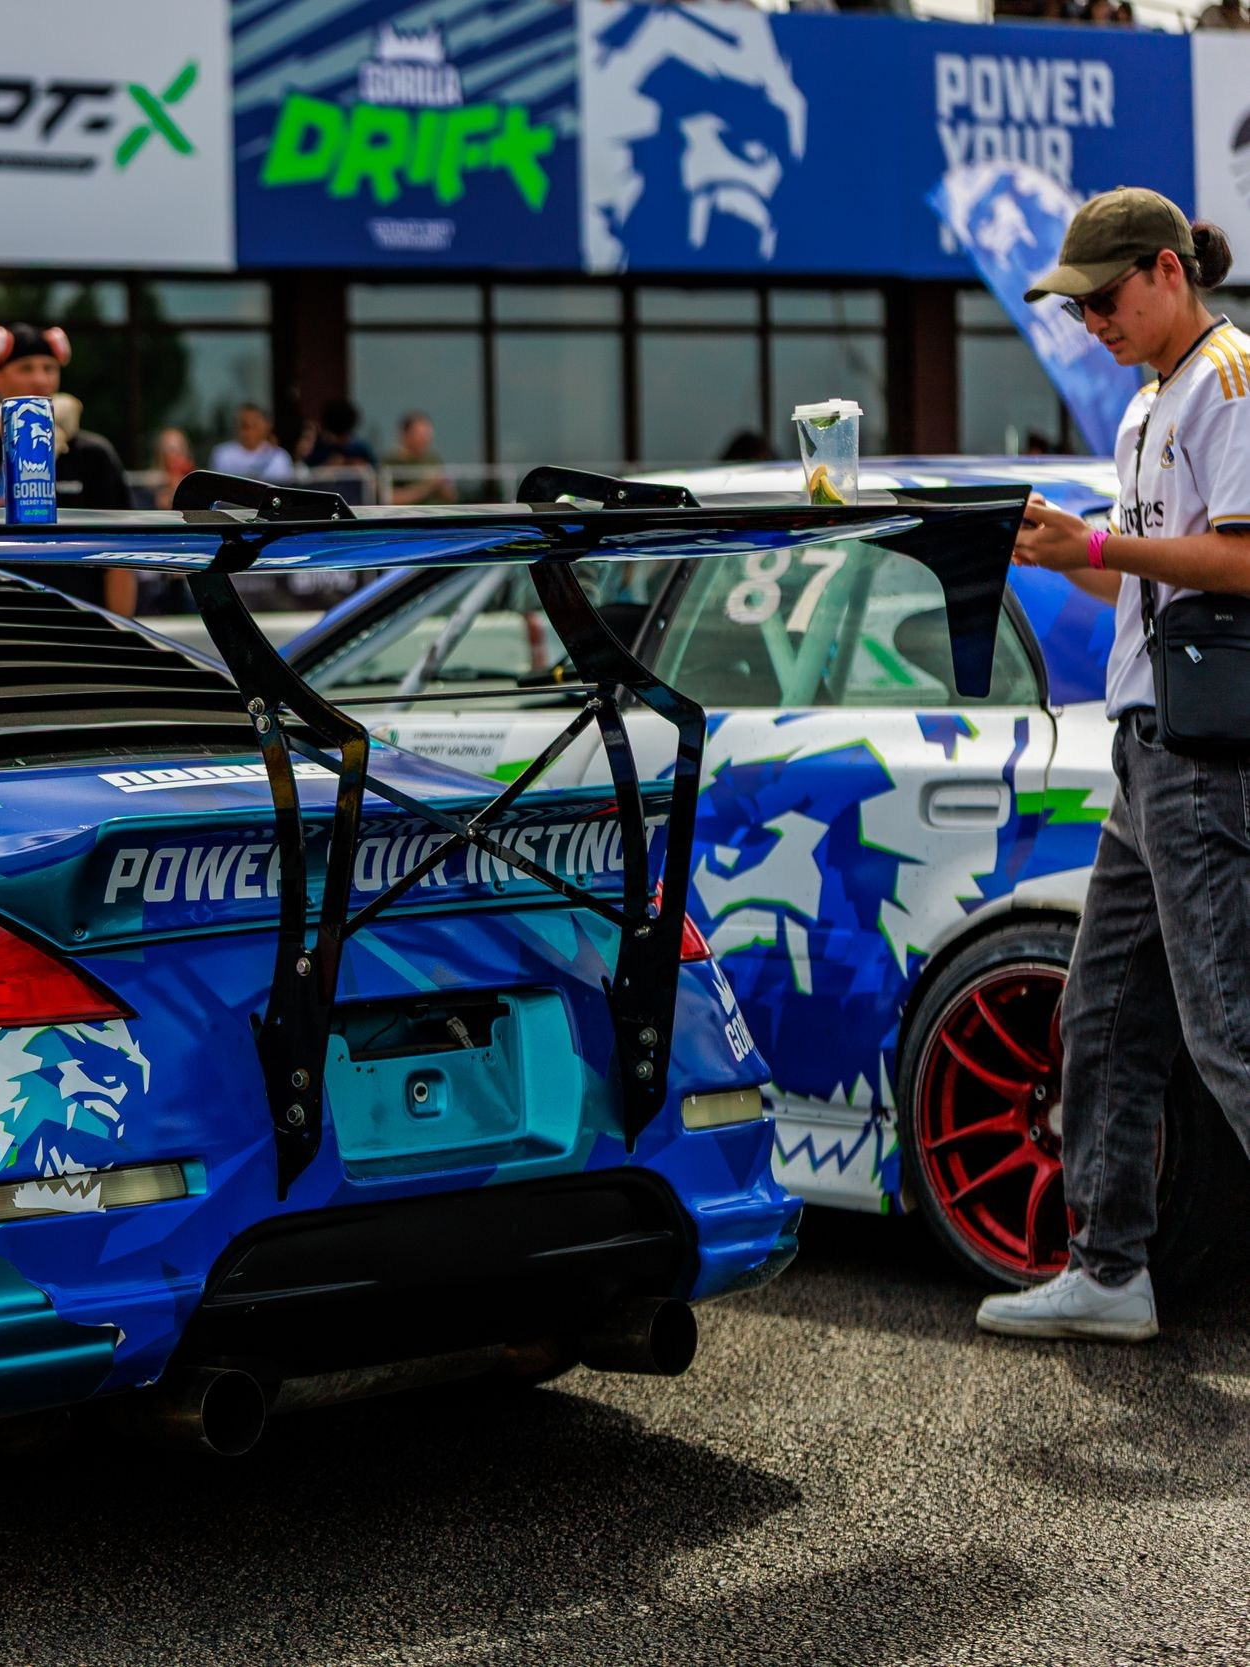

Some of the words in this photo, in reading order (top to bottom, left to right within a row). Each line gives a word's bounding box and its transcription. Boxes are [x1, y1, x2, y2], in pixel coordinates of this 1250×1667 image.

[359, 61, 463, 105] GORILLA
[936, 53, 1114, 127] POWER
[14, 482, 56, 499] GORILLA
[725, 548, 847, 632] 87
[327, 834, 451, 892] OUR
